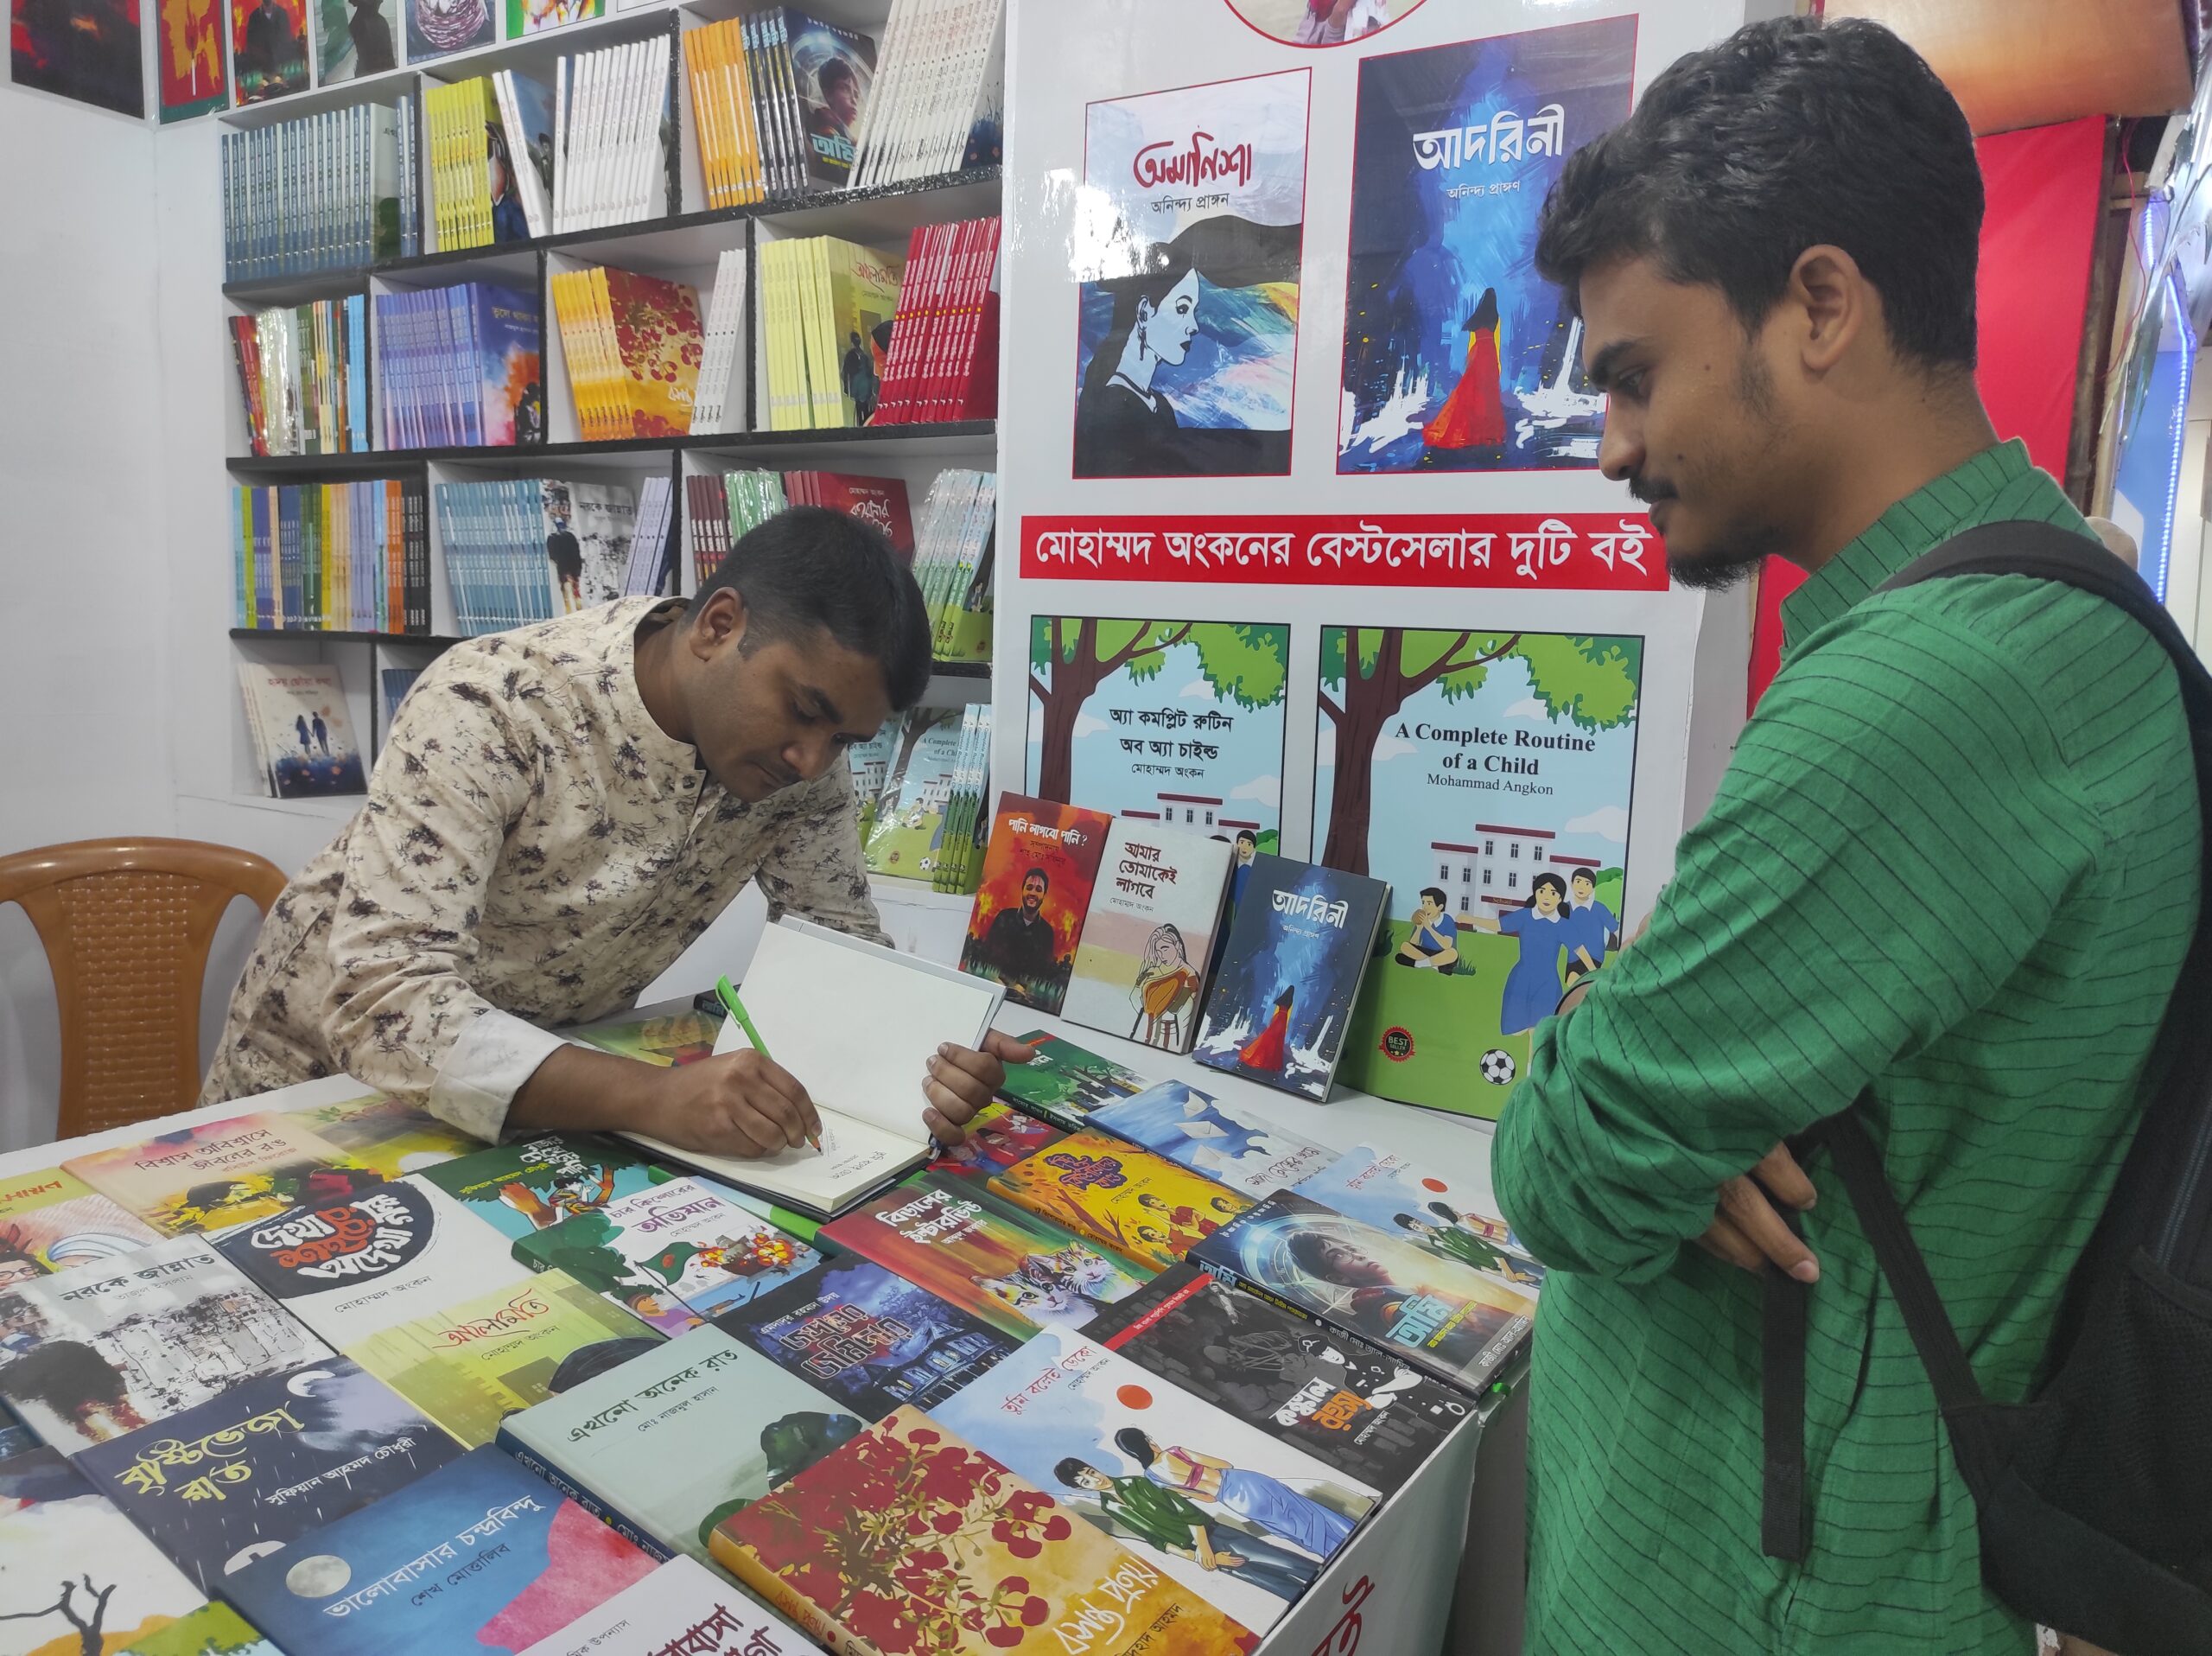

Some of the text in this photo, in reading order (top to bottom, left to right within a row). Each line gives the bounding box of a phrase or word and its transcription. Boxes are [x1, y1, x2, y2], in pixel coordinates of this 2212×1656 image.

[1412, 104, 1565, 170] আদরিনী
[1151, 195, 1192, 214] অনিন্দ্য
[1446, 183, 1485, 200] অনিন্দ্য
[1036, 526, 1156, 569] মোহাম্মদ
[1162, 532, 1296, 570] অংকনের
[1306, 519, 1498, 570] বেস্টসেলার
[1506, 519, 1578, 581] দুটি
[1587, 519, 1654, 576] বই
[1109, 708, 1234, 732] অ্যা কমপ্লিট রুটিন
[1395, 723, 1596, 752] A Complete Routine
[1120, 738, 1219, 761] অব অ্যা চাইল্ড
[1442, 753, 1539, 775] of a Child
[1132, 763, 1205, 779] মোহাম্মদ অংকন
[1427, 773, 1554, 796] Mohammad Angkon
[1008, 818, 1027, 834] পানি
[1061, 830, 1080, 845] পানি
[1116, 877, 1155, 899] লাগবে
[1119, 859, 1178, 885] তোমাকেই
[1272, 889, 1349, 929] আদরিনী
[1388, 1035, 1408, 1047] BEST
[134, 1129, 272, 1171] বিশ্বাস অবিশ্বাসে
[188, 1138, 286, 1170] জীবনের রঙ
[609, 1181, 697, 1220] চার কিশোরের
[632, 1195, 728, 1236] অভিযান
[874, 1187, 953, 1228] বিড়ালের
[251, 1214, 336, 1248] দেখা
[899, 1198, 984, 1246] ইন্টারভিউ
[296, 1226, 414, 1278] অদেখা
[58, 1254, 215, 1301] নরকে জান্নাত
[334, 1275, 432, 1314] মোহাম্মদ অংকন
[1327, 1323, 1351, 1341] কাজী
[1385, 1293, 1452, 1350] অমি
[567, 1346, 741, 1443] এখনো অনেক রাত
[1000, 1345, 1096, 1415] তুমি বলেই ডেকো
[636, 1385, 721, 1432] মোঃ নাজমুল হাসান
[1268, 1376, 1336, 1426] কঙ্কাল
[1312, 1388, 1372, 1430] রহস্য
[114, 1400, 304, 1496] বৃষ্টিভেজা
[173, 1459, 251, 1501] রাত
[264, 1436, 416, 1505] সুফিয়ান আহমদ চৌধুরী
[322, 1492, 546, 1618] ভালোবাসার চন্দ্রবিন্দু
[410, 1580, 444, 1606] শেখ
[588, 1618, 631, 1640] উপন্যাস
[1149, 1602, 1185, 1636] আহমদ
